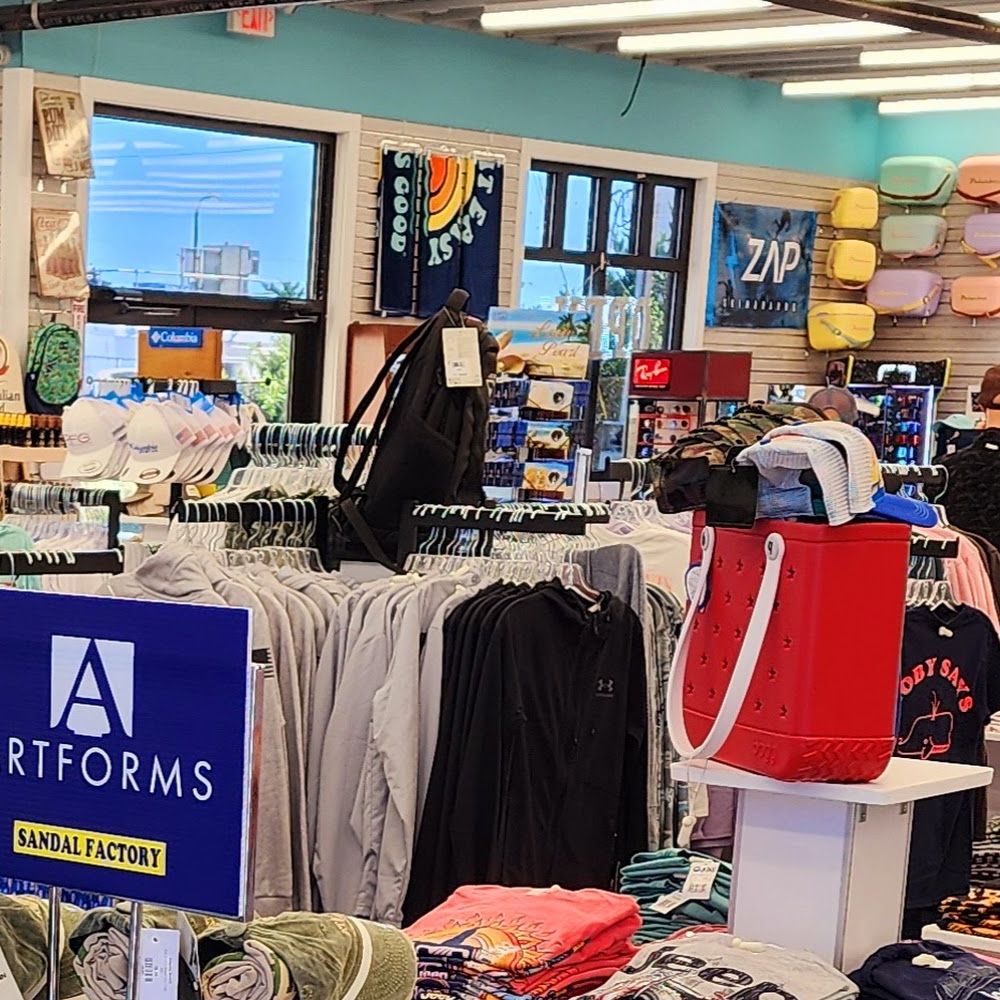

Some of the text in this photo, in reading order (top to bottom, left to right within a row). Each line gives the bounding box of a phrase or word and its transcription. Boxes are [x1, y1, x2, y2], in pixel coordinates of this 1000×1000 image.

[740, 238, 801, 284] ZAP
[160, 331, 199, 344] Columbia
[901, 656, 974, 713] OBY SAYS
[17, 828, 162, 869] SANDAL FACTORY
